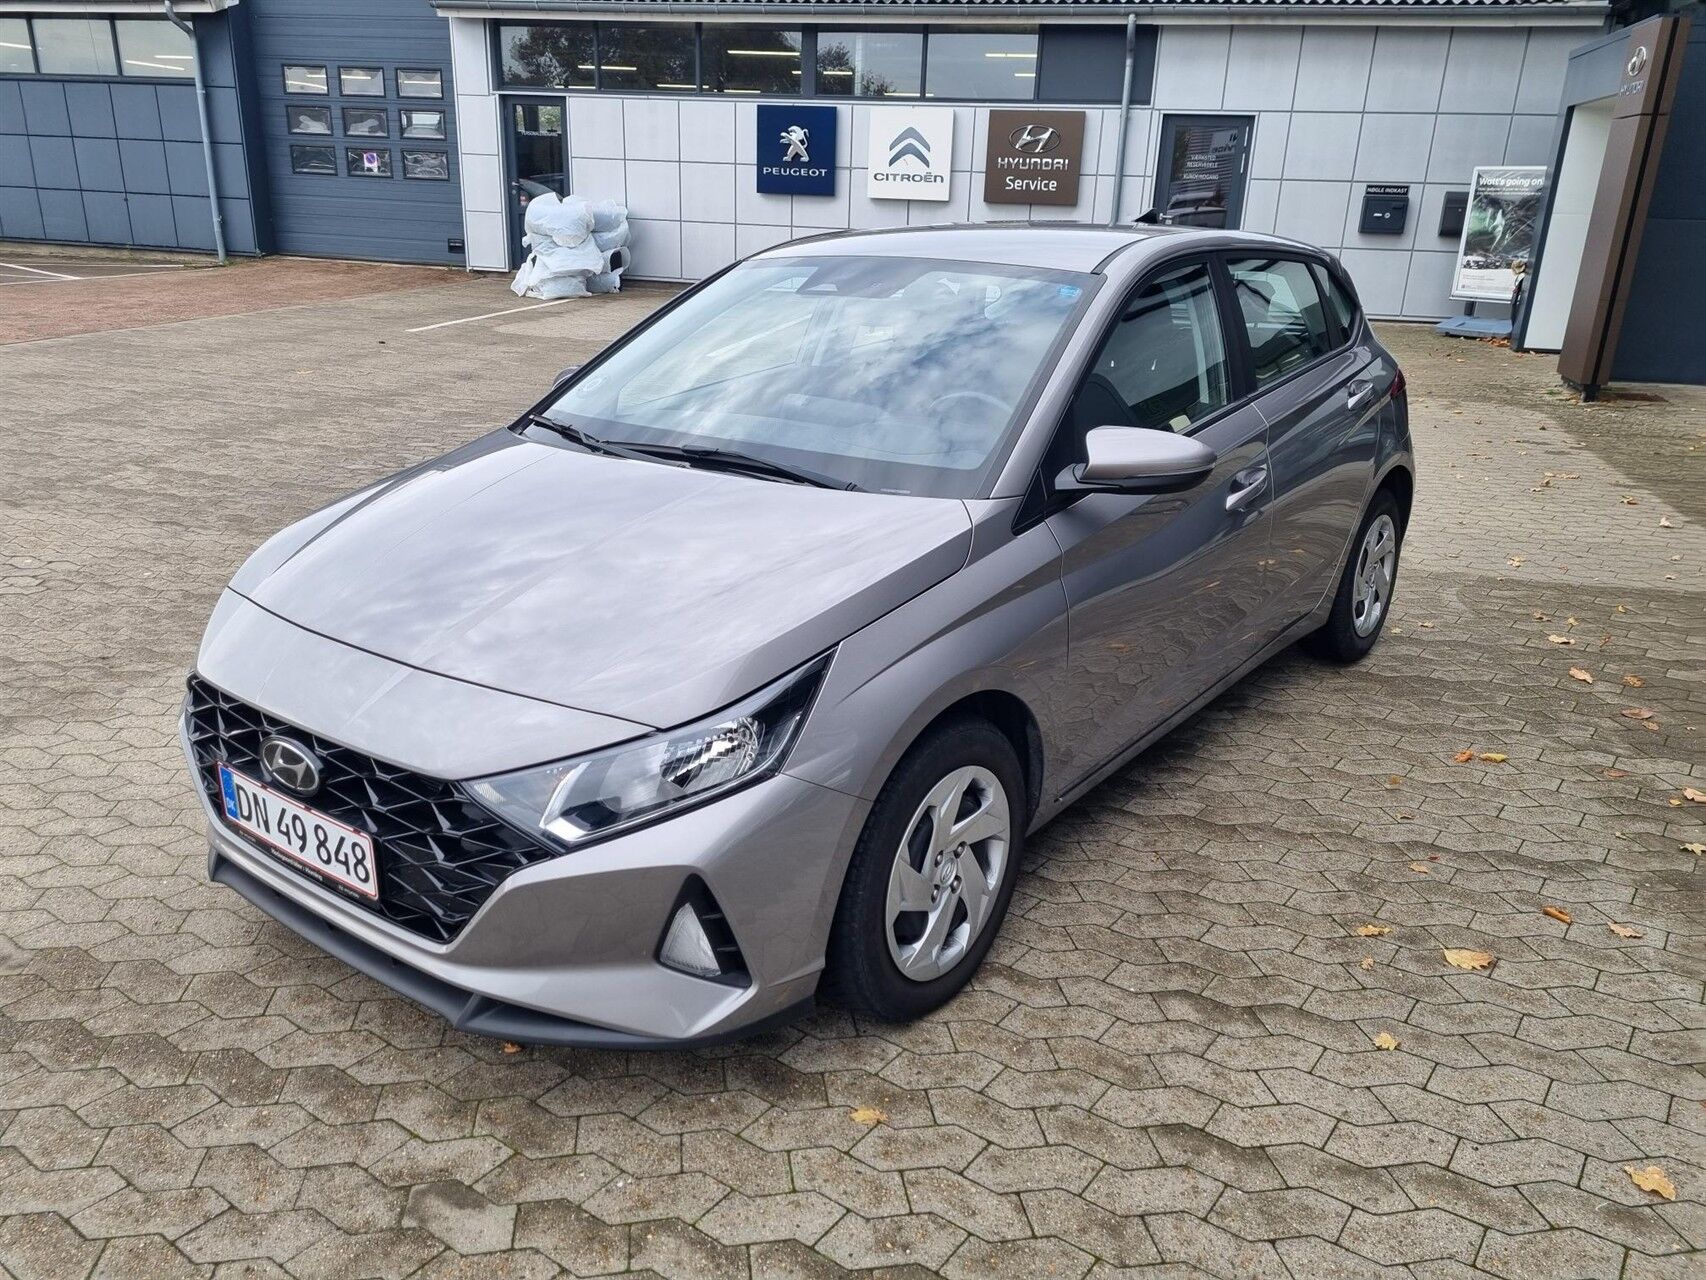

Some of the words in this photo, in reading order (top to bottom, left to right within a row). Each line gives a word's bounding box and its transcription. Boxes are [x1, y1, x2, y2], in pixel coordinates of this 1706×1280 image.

[997, 157, 1069, 171] HYUNDAI
[763, 166, 827, 177] PEUGEOT
[873, 171, 944, 183] CITROËN
[1005, 176, 1057, 191] Service
[1505, 177, 1531, 187] going
[236, 782, 270, 834] DN
[277, 808, 308, 854] 49
[313, 823, 370, 884] 848
